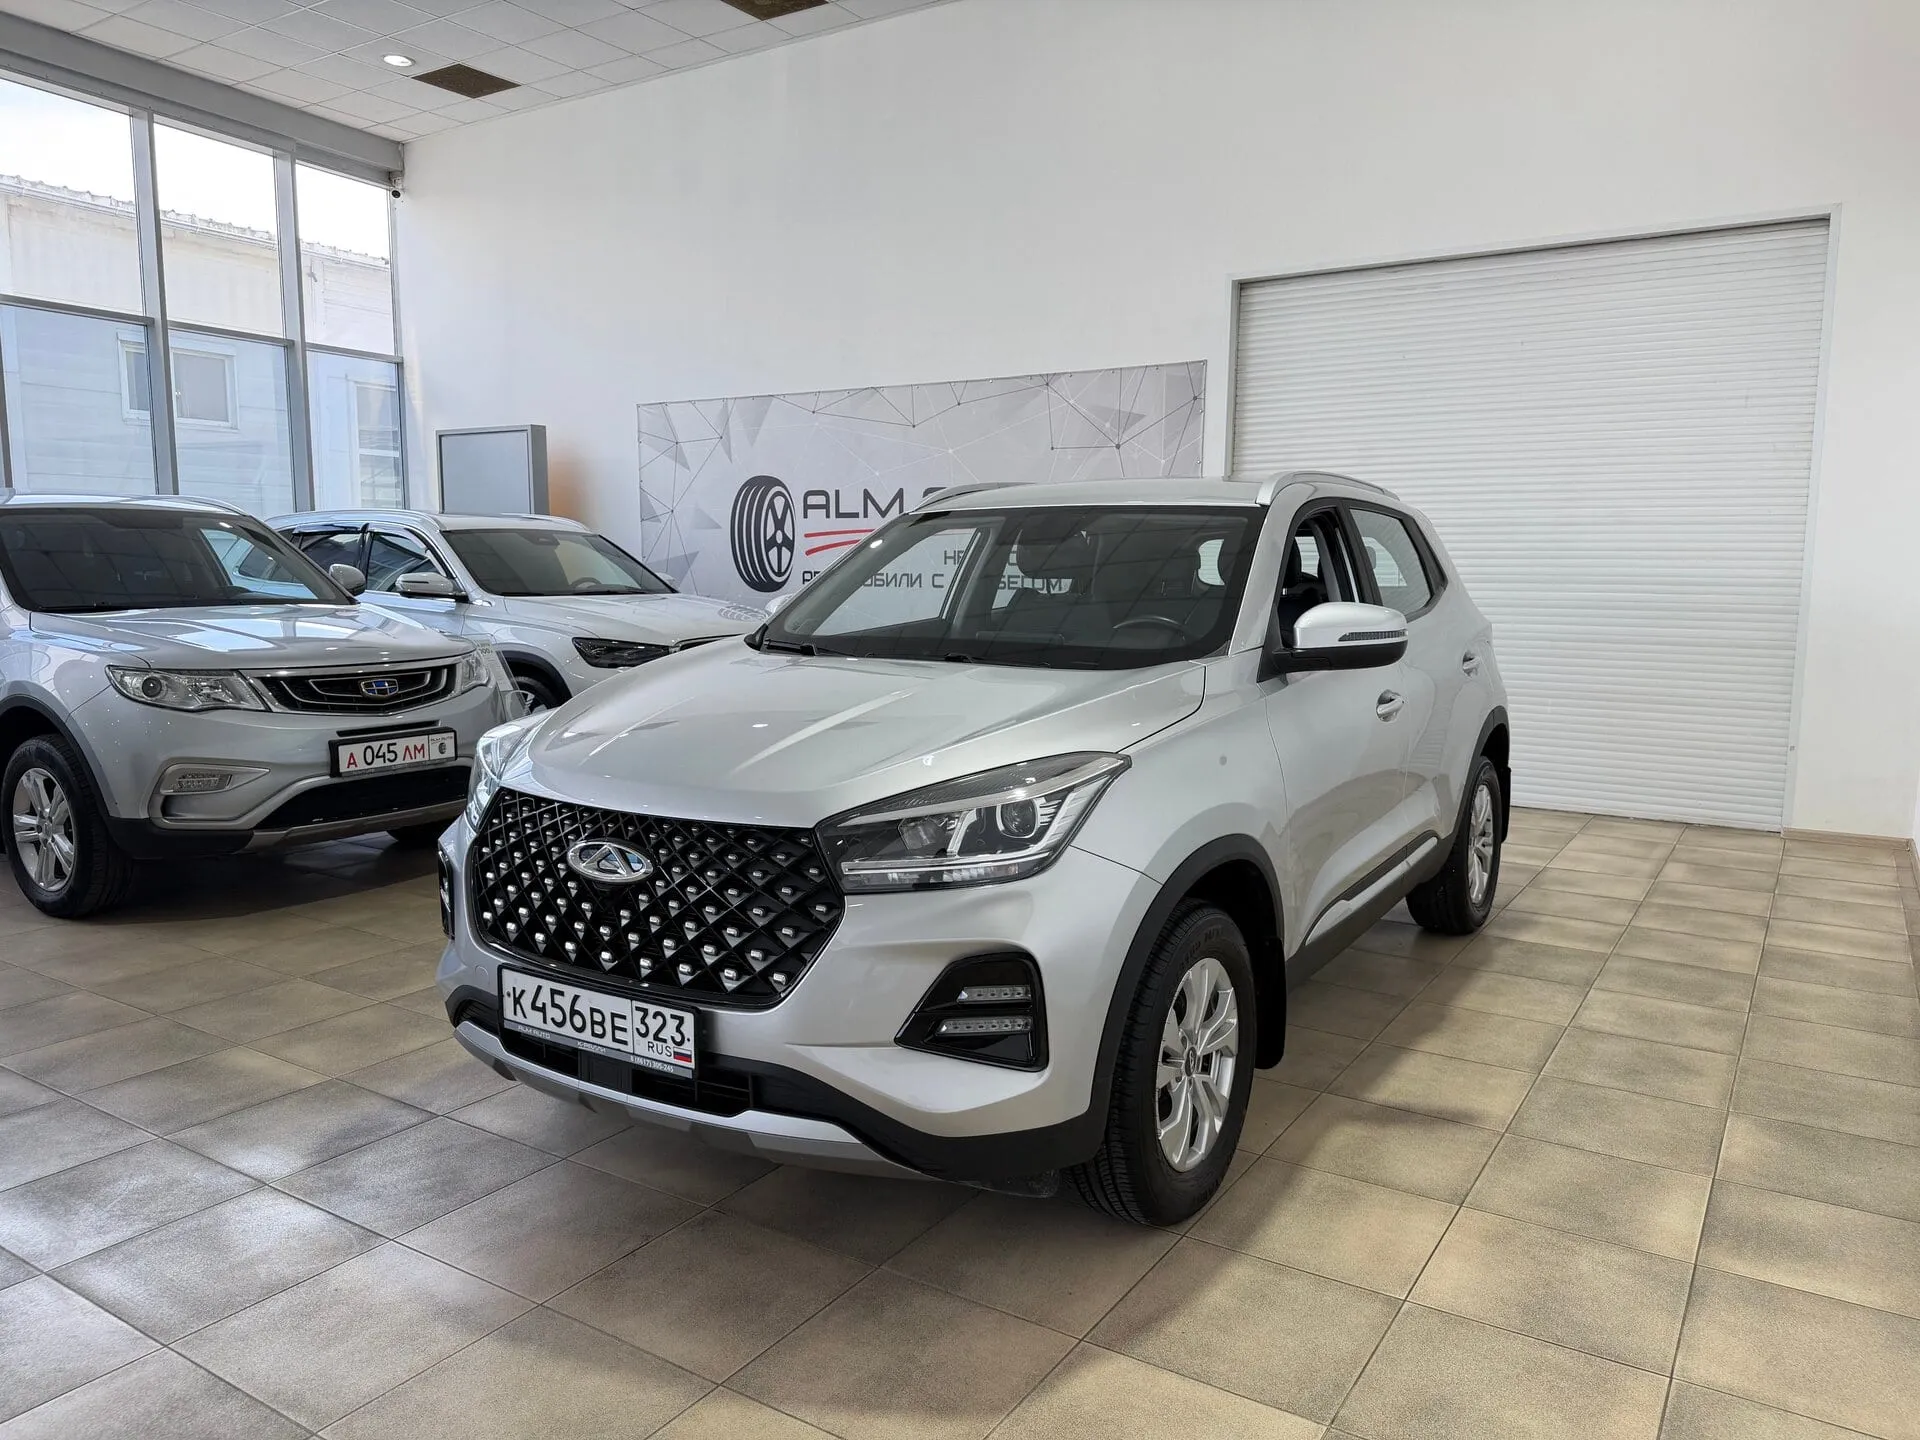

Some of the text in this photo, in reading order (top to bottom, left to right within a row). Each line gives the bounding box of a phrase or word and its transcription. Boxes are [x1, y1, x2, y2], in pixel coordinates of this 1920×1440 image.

[803, 488, 904, 519] ALM
[363, 743, 398, 766] 045
[635, 1006, 686, 1047] 323
[647, 1041, 672, 1057] RUS
